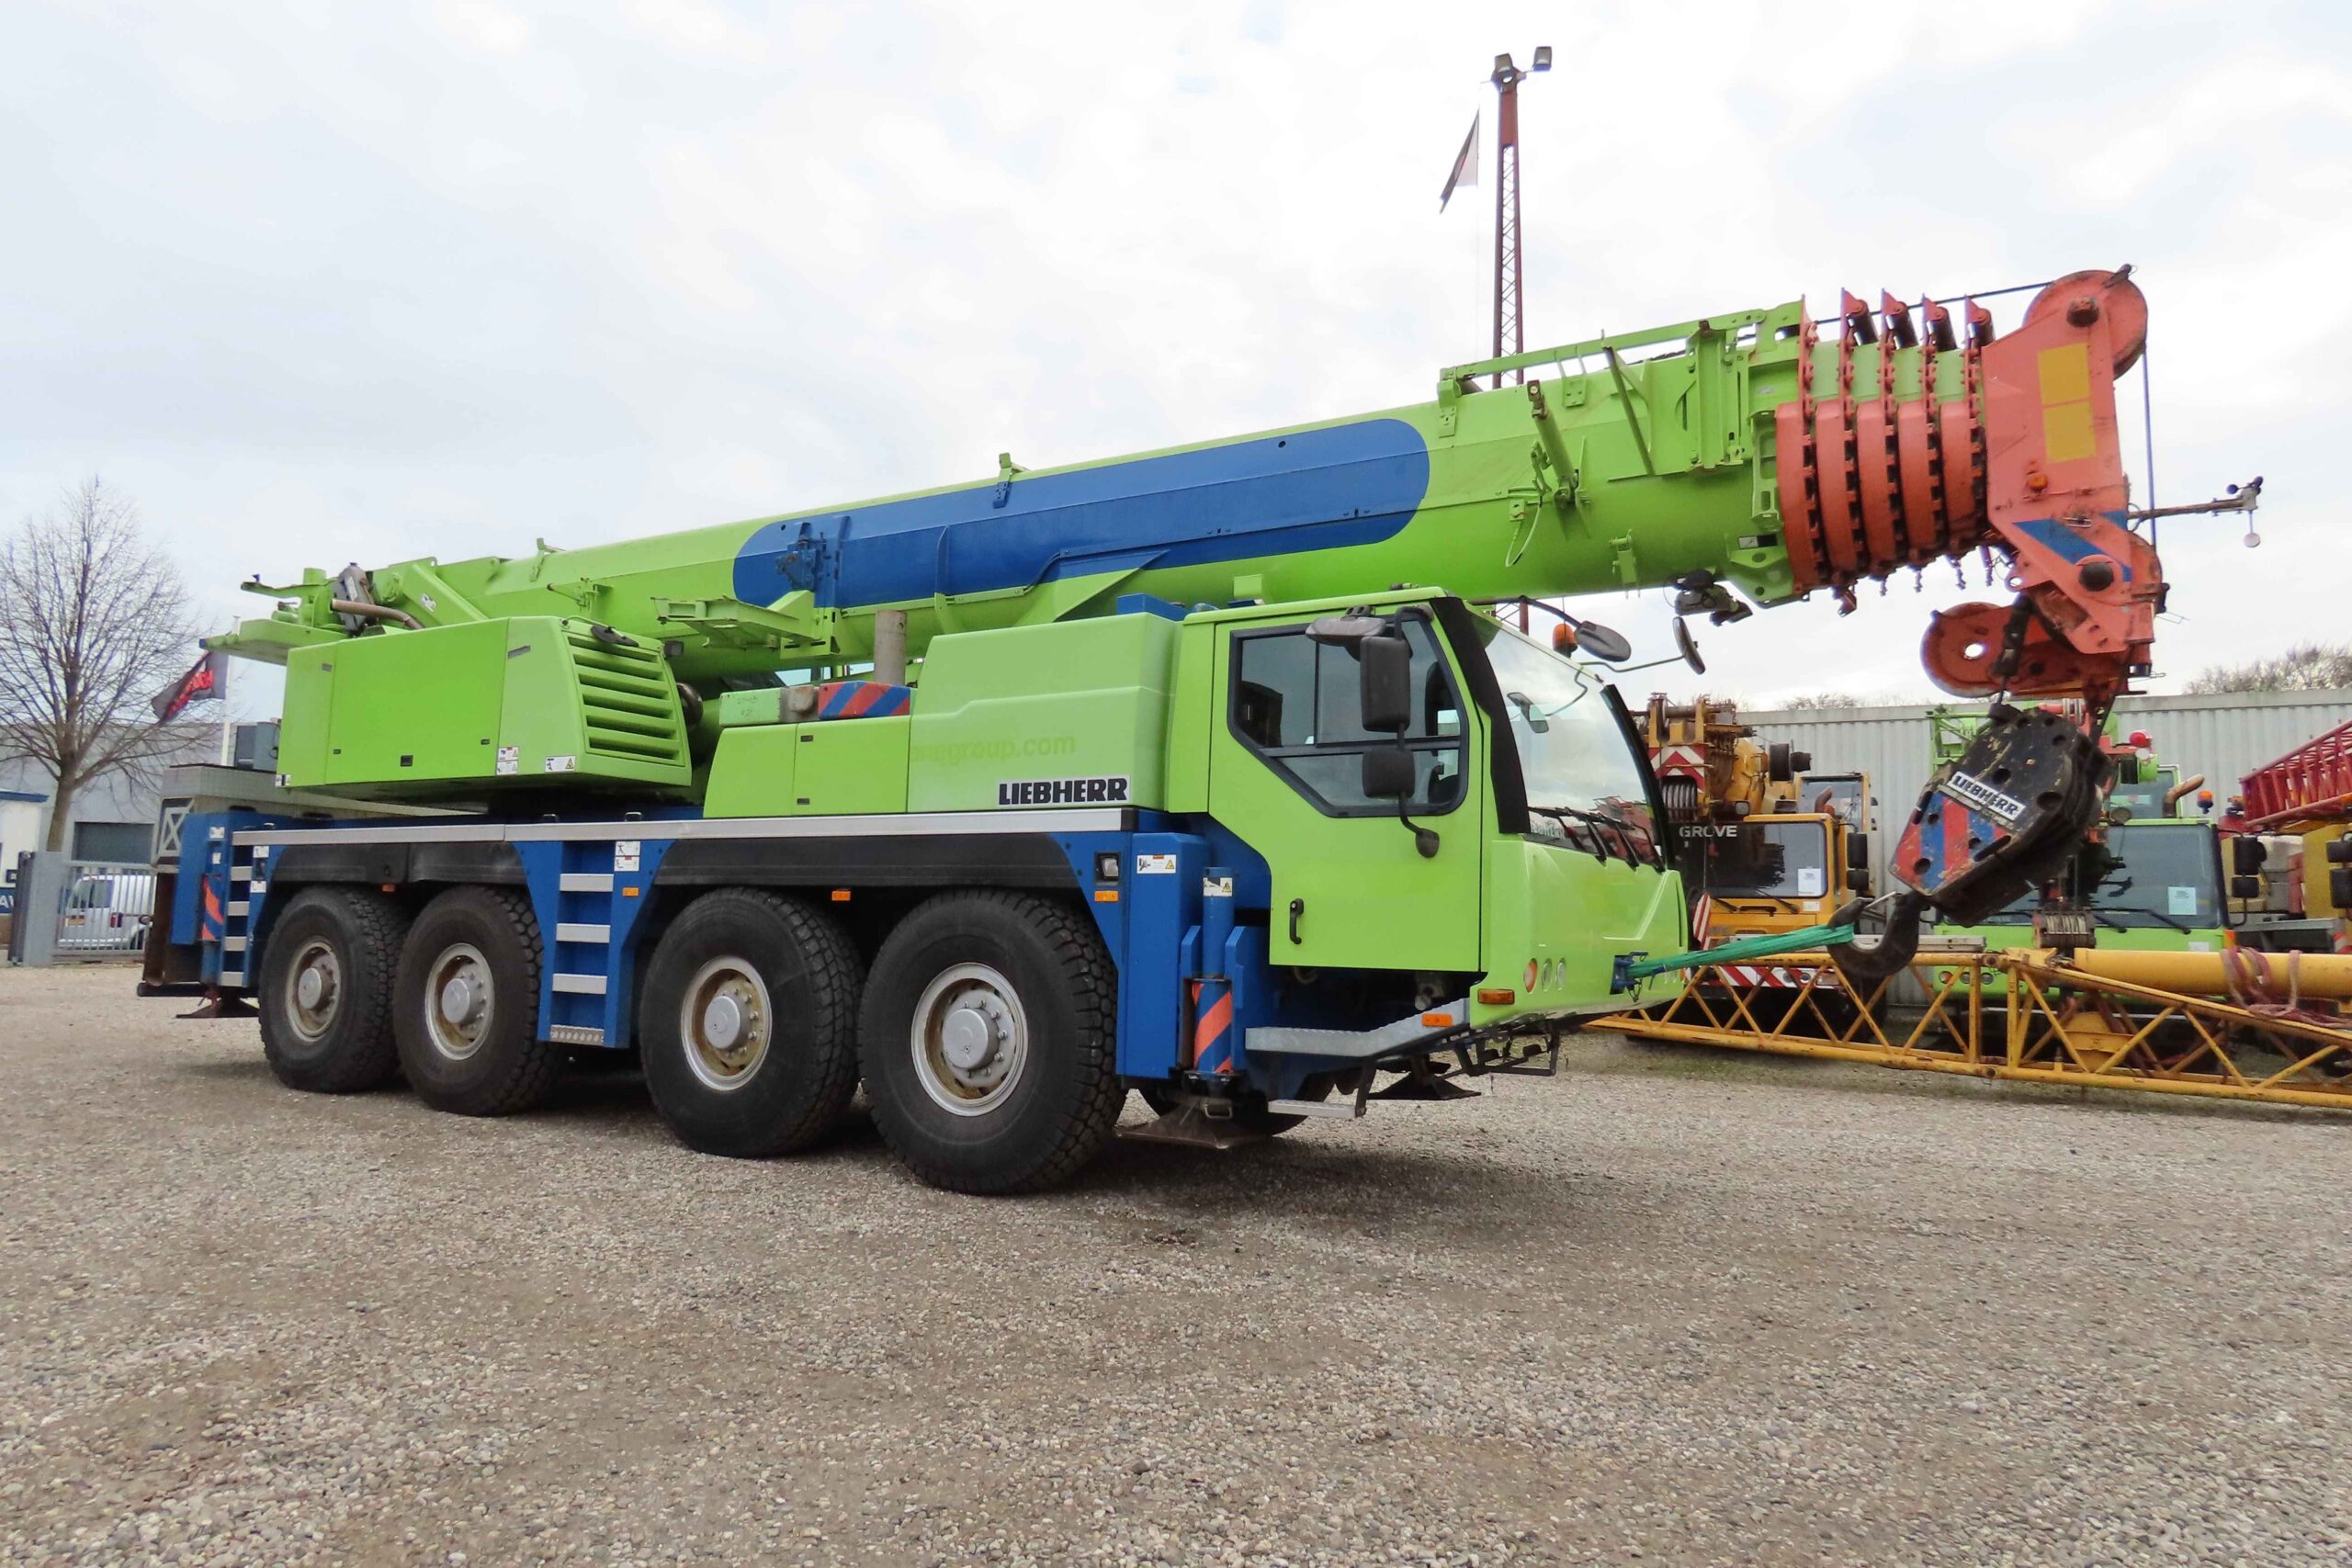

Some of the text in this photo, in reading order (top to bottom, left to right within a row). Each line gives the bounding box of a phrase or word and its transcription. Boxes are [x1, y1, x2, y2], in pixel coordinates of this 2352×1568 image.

[999, 778, 1128, 806] LIEBHERR
[1952, 775, 2018, 816] LIEBHERR
[1679, 825, 1737, 838] GROVE
